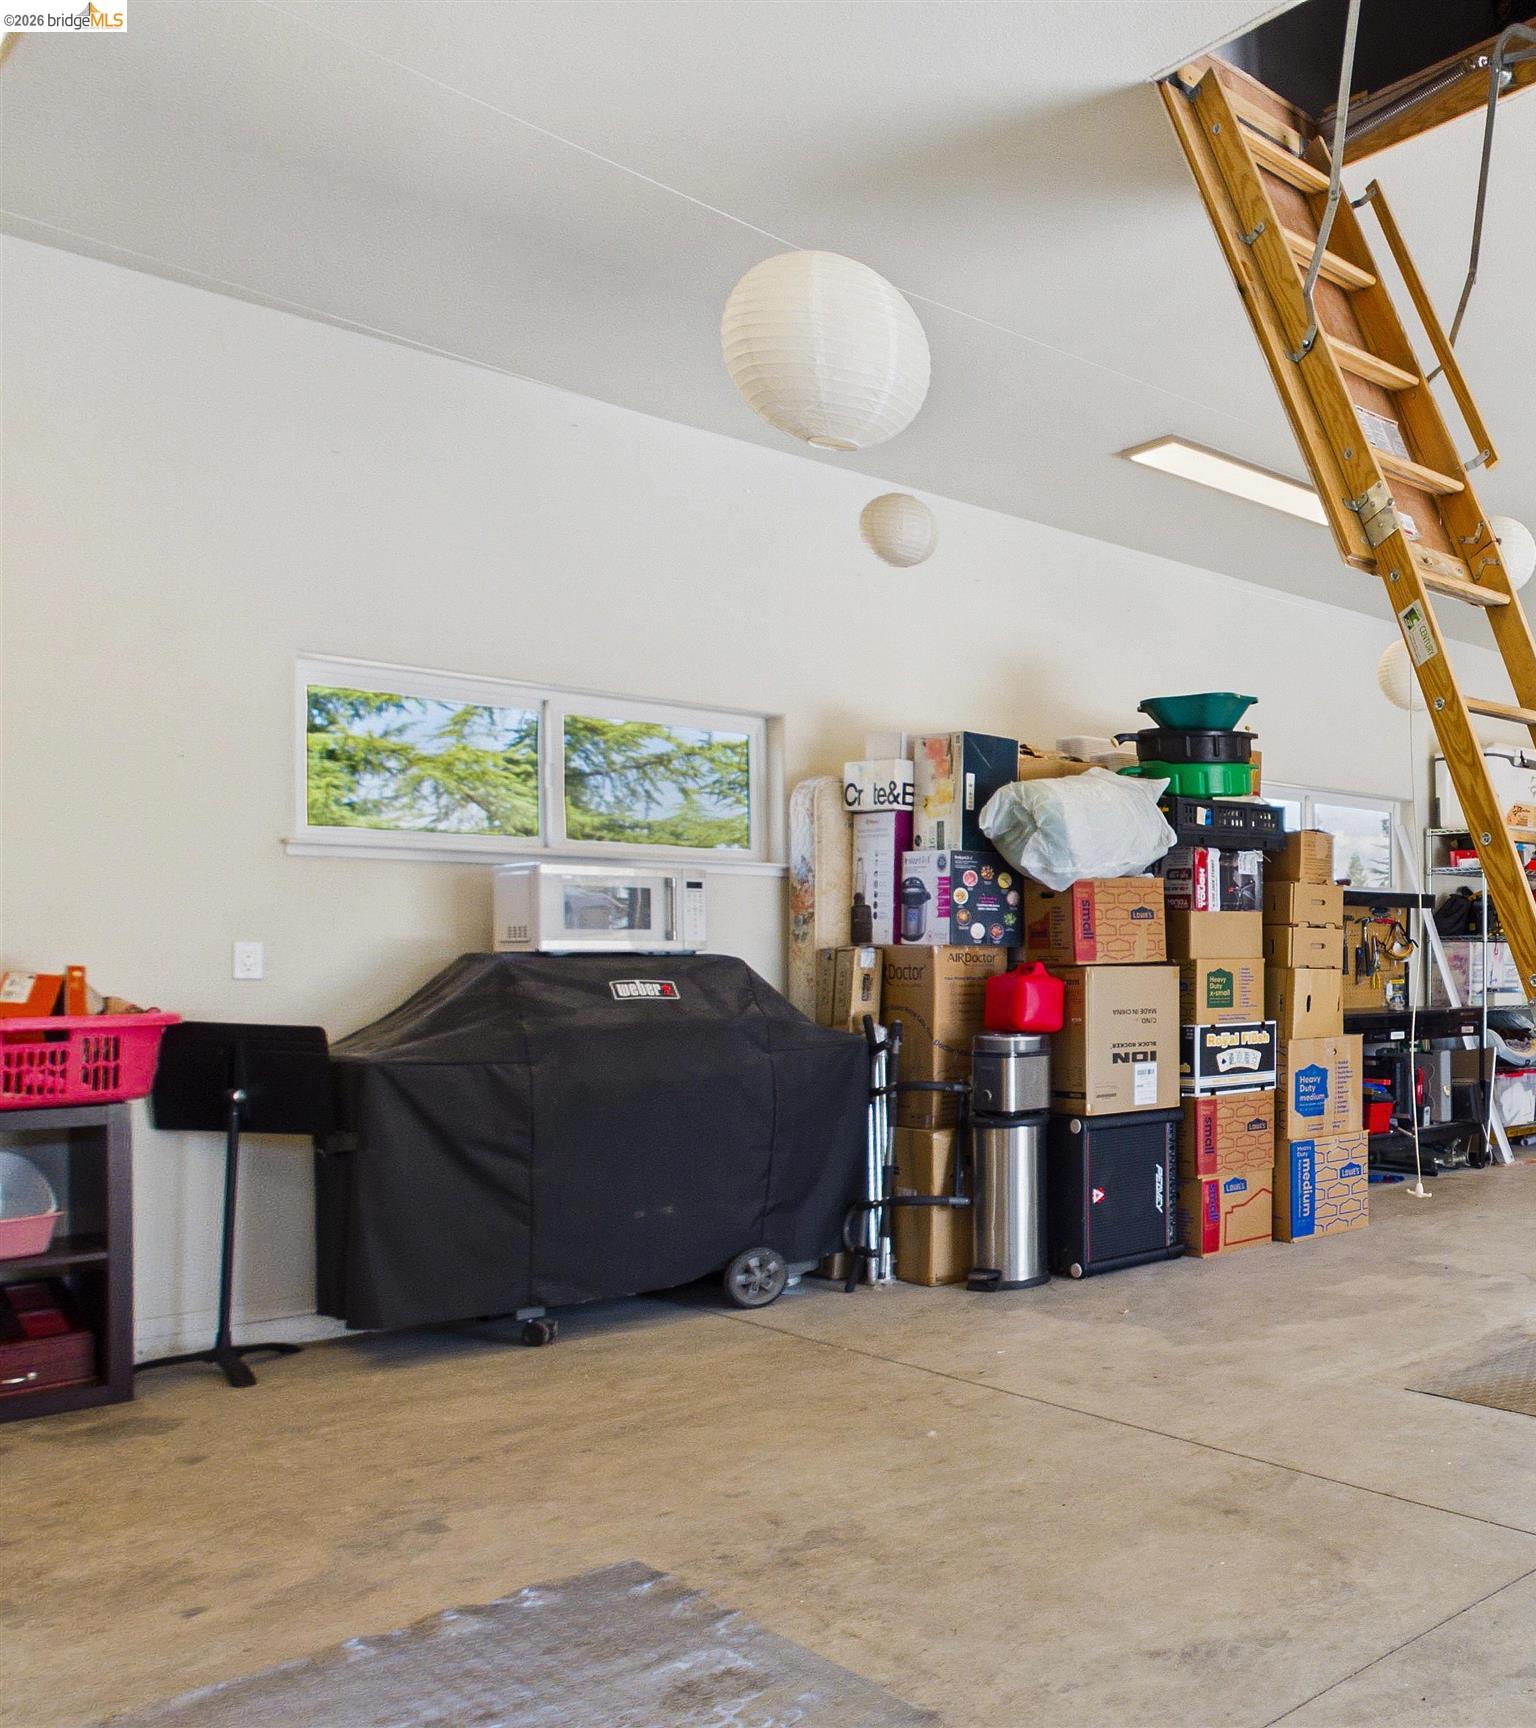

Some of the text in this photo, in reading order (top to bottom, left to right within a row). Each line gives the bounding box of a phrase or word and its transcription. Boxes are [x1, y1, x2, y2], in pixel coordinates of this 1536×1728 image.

[1420, 625, 1434, 656] CENTURY
[844, 780, 914, 807] Crte&B
[1081, 899, 1094, 940] small
[615, 980, 661, 996] weber
[1206, 1032, 1240, 1048] Royal
[1240, 1030, 1270, 1045] Flush
[1112, 1051, 1157, 1064] ION
[1299, 1076, 1321, 1084] Heavy
[1299, 1085, 1316, 1093] Duty
[1204, 1117, 1215, 1155] small
[1302, 1158, 1312, 1217] medium
